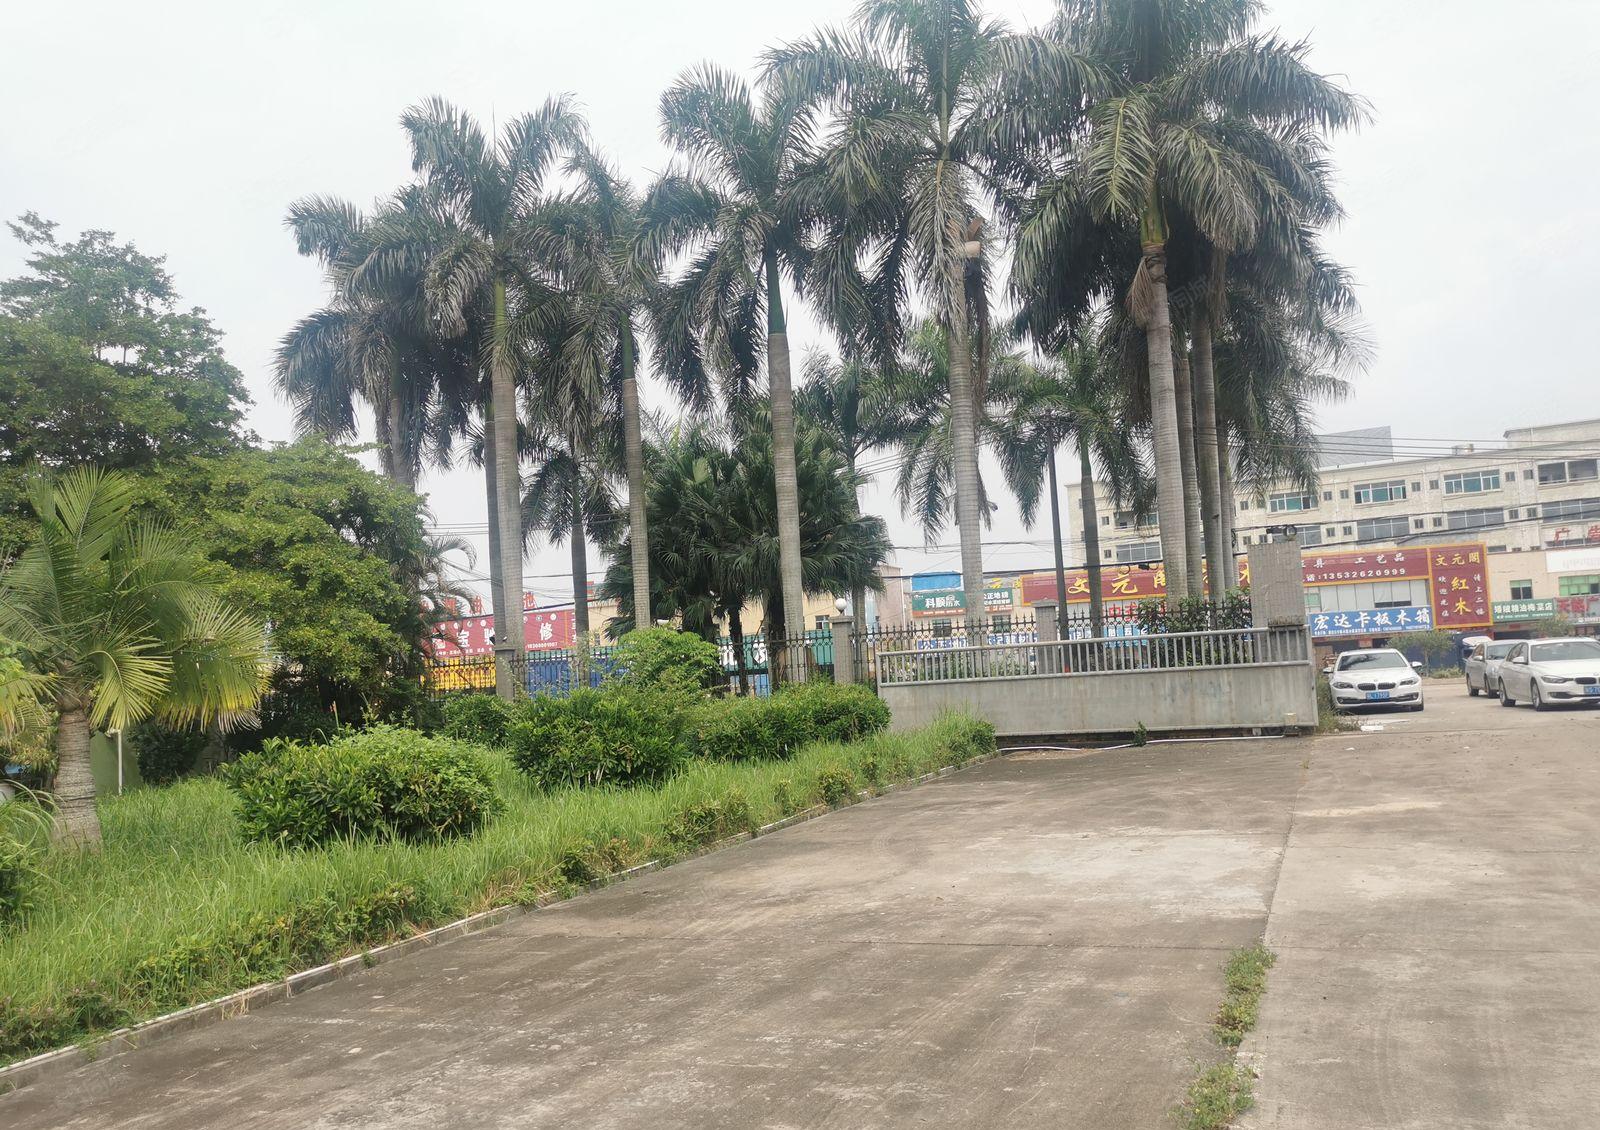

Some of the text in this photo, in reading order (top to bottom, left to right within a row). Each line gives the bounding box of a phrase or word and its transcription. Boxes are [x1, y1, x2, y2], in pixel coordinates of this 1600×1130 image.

[1354, 552, 1405, 565] 工艺品
[1314, 608, 1430, 631] 宏达卡板木箱
